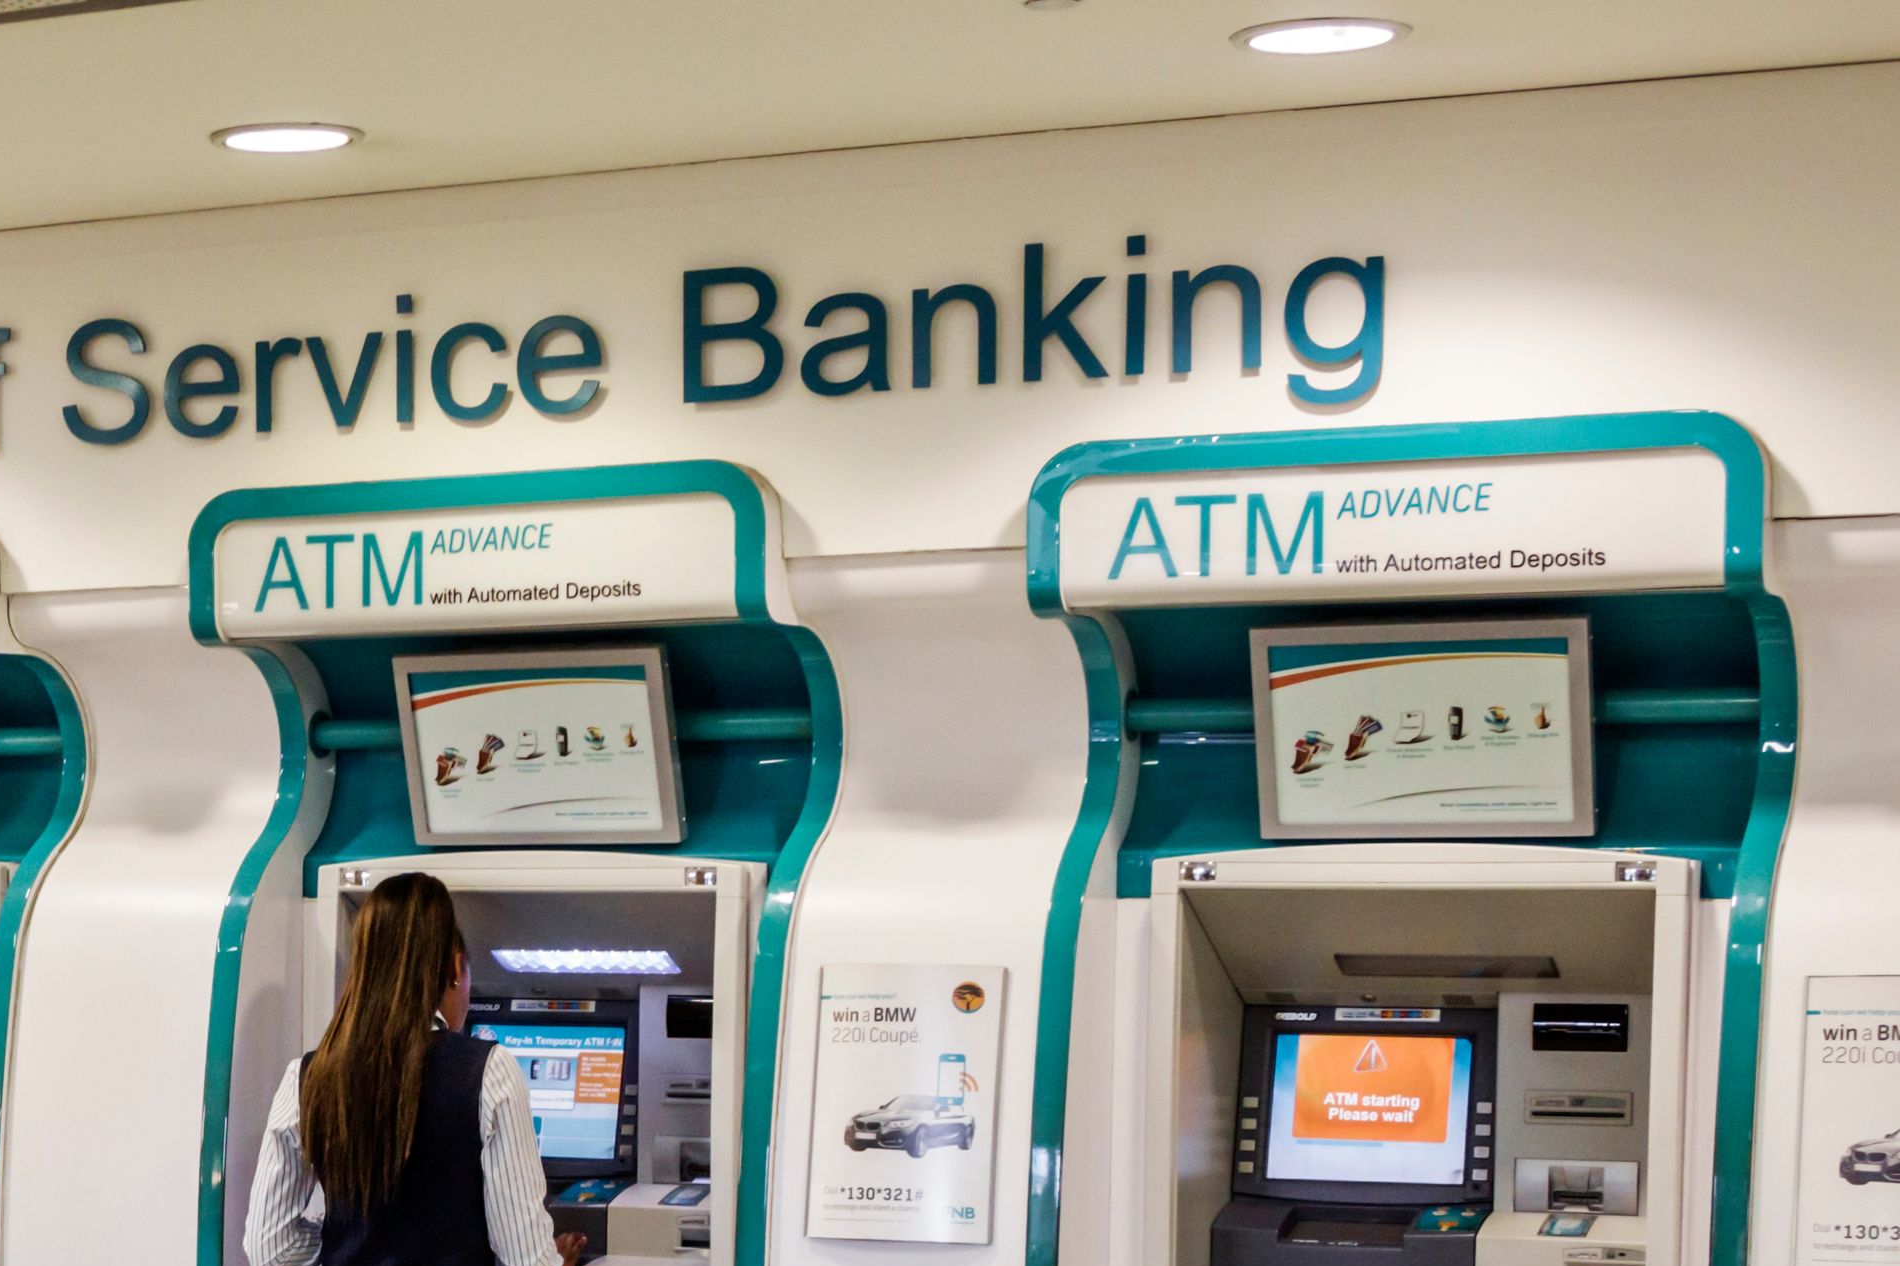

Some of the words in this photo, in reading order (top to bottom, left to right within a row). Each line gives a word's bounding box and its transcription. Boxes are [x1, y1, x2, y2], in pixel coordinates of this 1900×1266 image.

[62, 293, 603, 447] Service
[682, 235, 1385, 405] Banking
[1107, 489, 1325, 581] ATM
[1336, 482, 1493, 520] ADVANCE
[253, 530, 424, 613] ATM
[430, 522, 553, 555] ADVANCE
[1336, 552, 1378, 574] with
[1384, 550, 1502, 572] Automated
[1510, 547, 1607, 571] Deposits
[430, 586, 463, 605] with
[467, 584, 560, 603] Automated
[565, 580, 642, 604] Deposits
[833, 1007, 859, 1022] win
[862, 1010, 870, 1022] a
[874, 1007, 917, 1022] BMW
[832, 1027, 865, 1043] 220i
[1823, 1024, 1858, 1041] win
[1862, 1027, 1872, 1041] a
[535, 1036, 582, 1048] Temporary
[584, 1037, 605, 1046] ATM
[1822, 1046, 1866, 1064] 220i
[1324, 1092, 1358, 1105] ATM
[1361, 1094, 1420, 1110] starting
[1328, 1107, 1378, 1121] Please
[1382, 1110, 1414, 1123] wait
